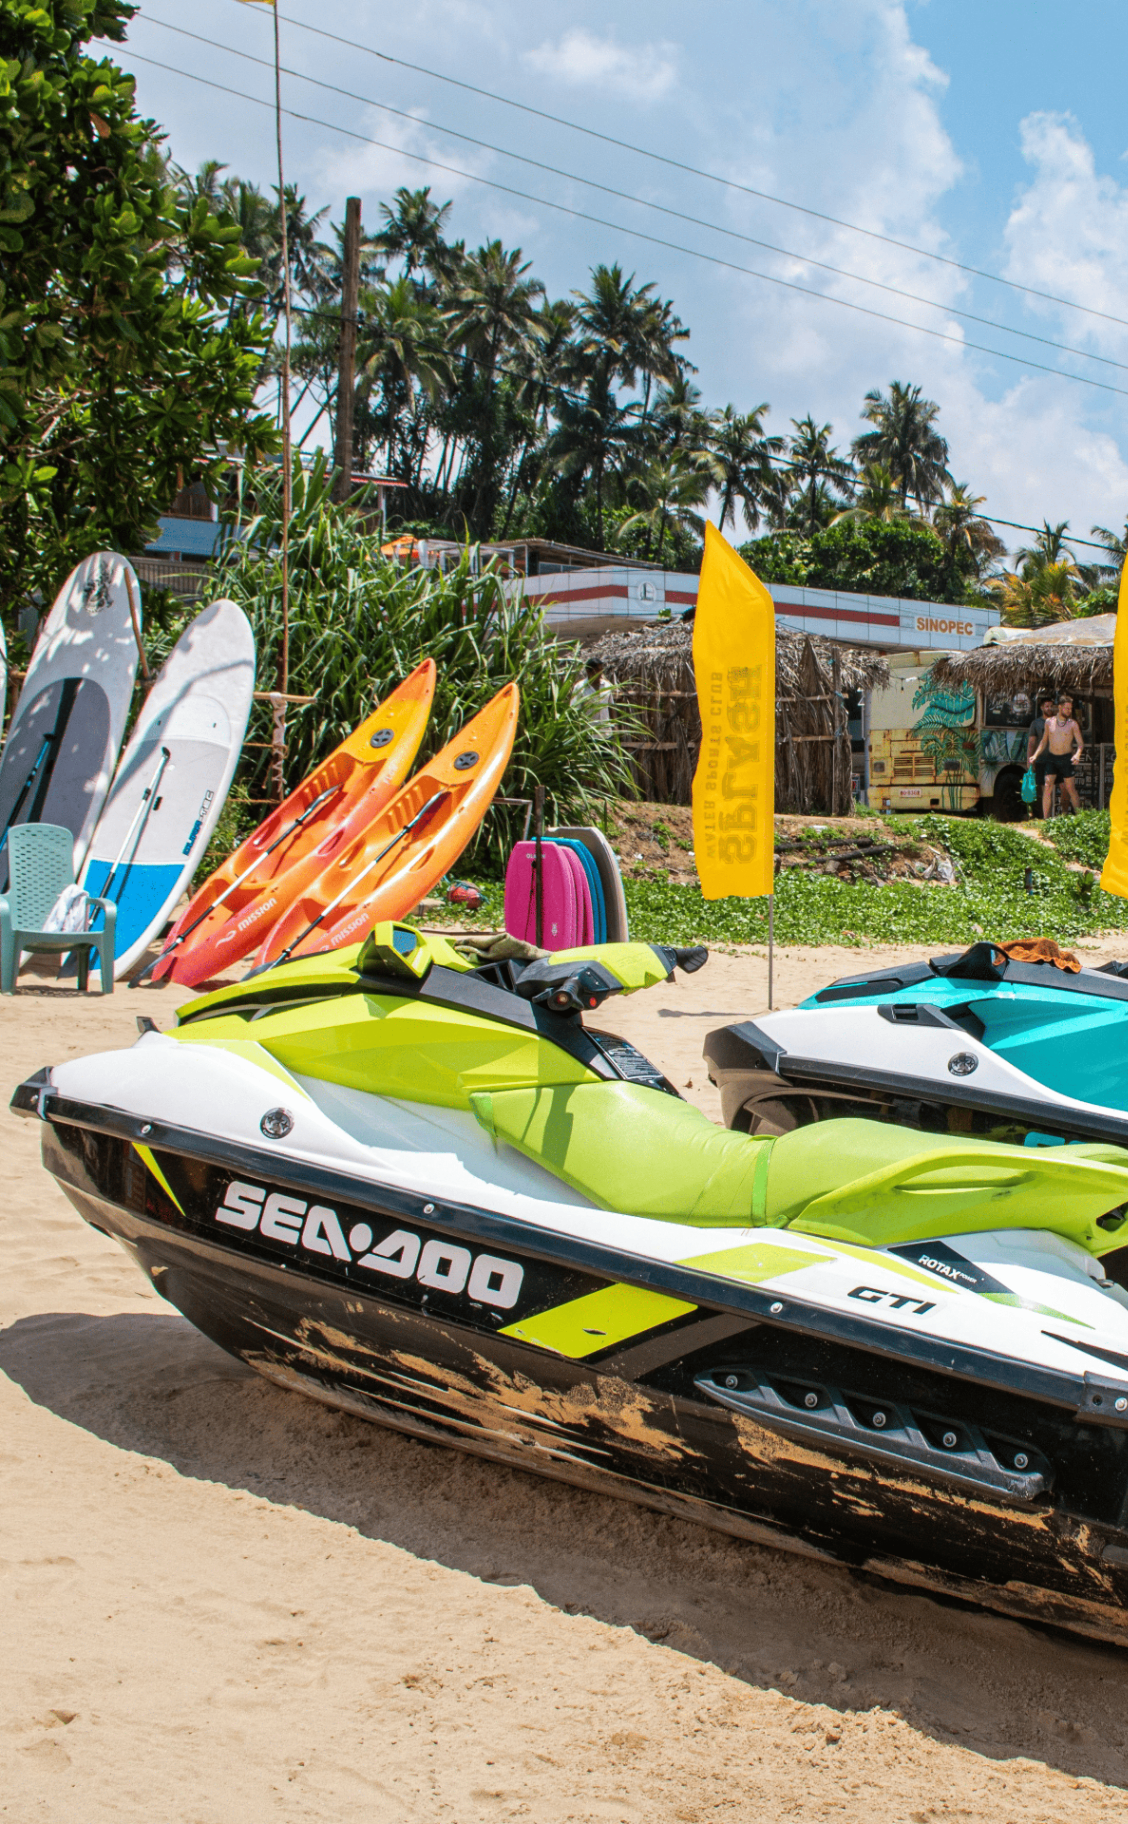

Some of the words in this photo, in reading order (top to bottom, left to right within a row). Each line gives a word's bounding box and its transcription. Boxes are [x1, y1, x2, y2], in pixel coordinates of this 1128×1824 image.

[916, 616, 974, 636] SINOPEC
[237, 896, 277, 932] mission
[330, 912, 370, 946] mission
[918, 1254, 961, 1281] ROTAX
[847, 1286, 937, 1315] GTI
